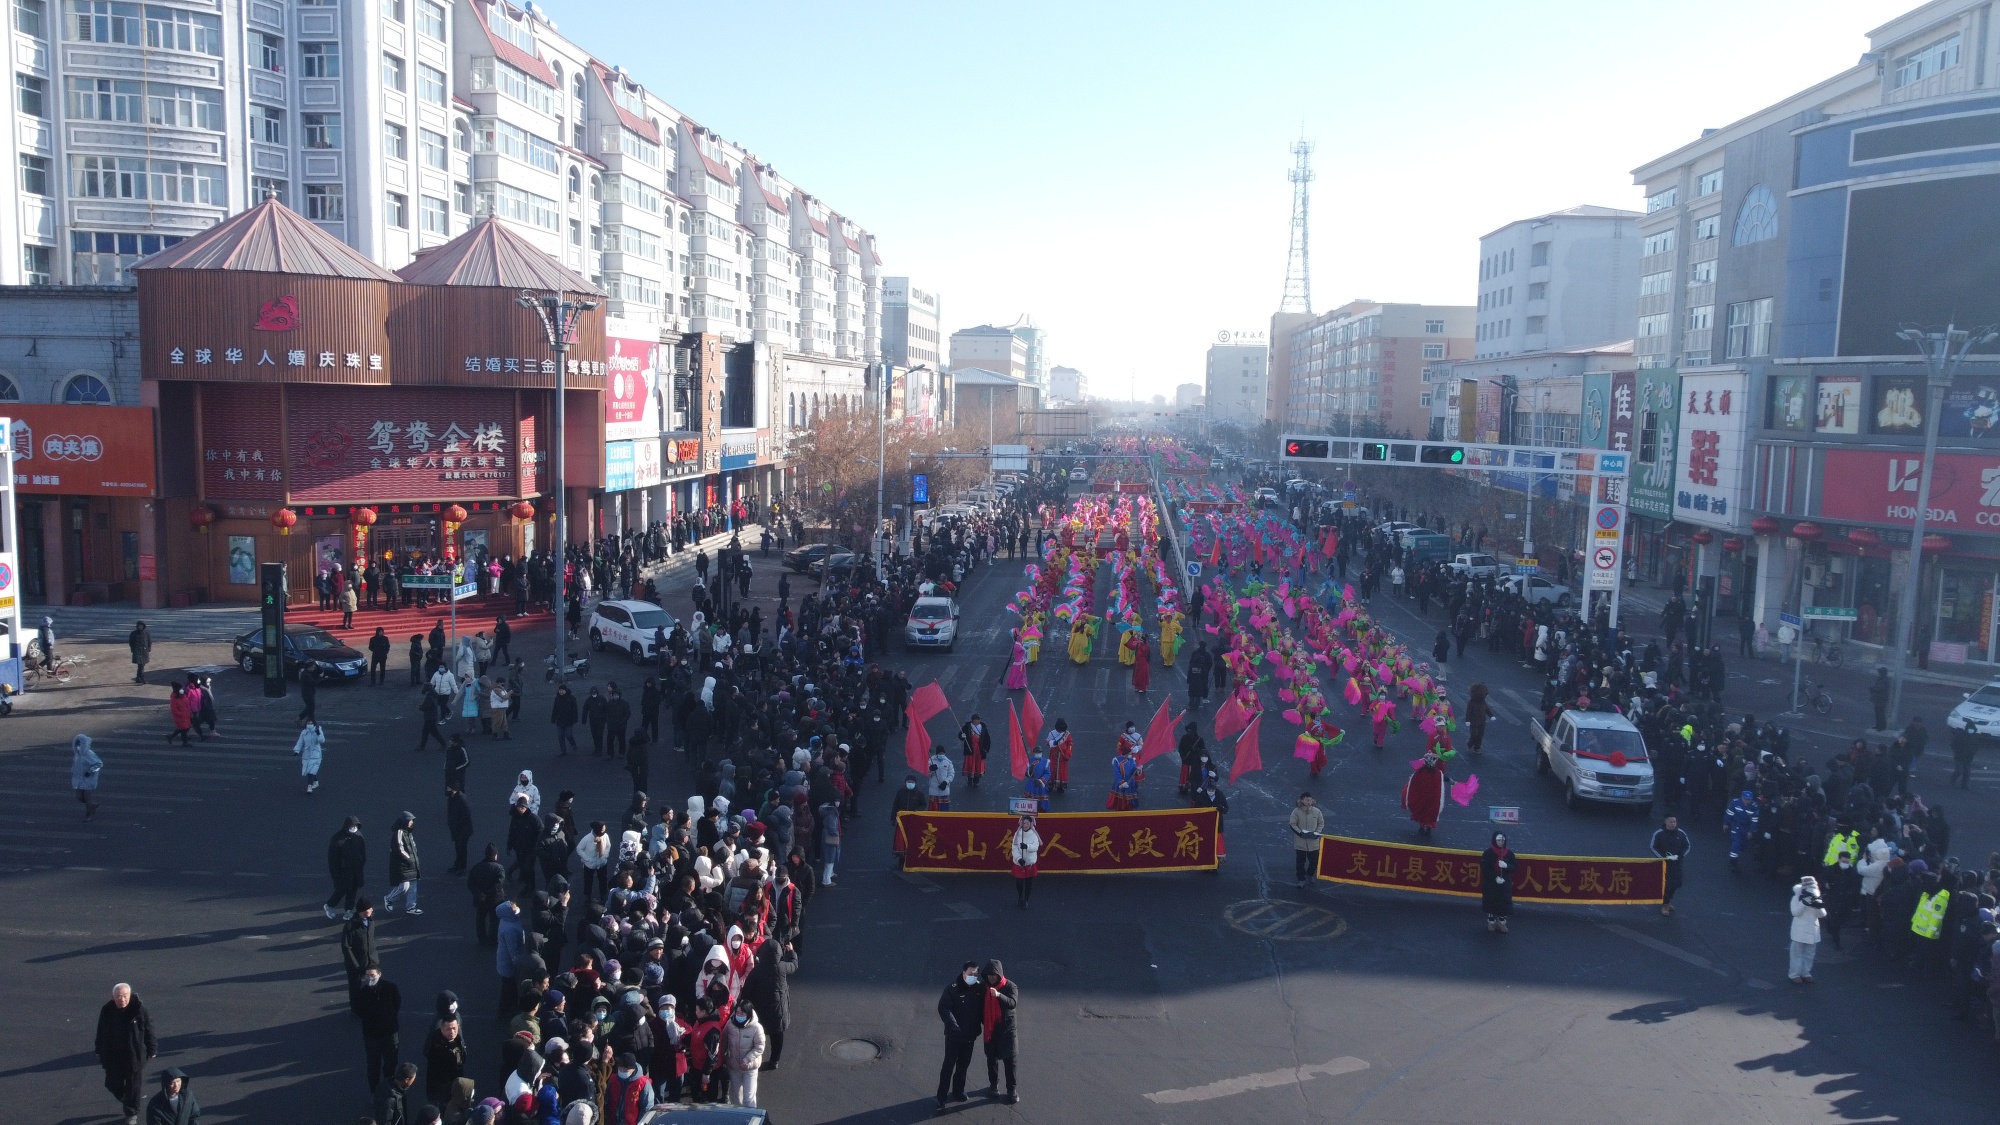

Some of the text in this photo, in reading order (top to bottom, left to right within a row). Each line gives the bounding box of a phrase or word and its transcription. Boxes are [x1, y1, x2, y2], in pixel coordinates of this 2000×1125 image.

[170, 346, 383, 371] 全球华人婚庆珠宝
[465, 356, 556, 374] 结婚买三金
[367, 419, 507, 454] 鸳鸯金楼
[47, 439, 99, 456] 肉夹馍
[206, 449, 264, 462] 你中有我
[370, 456, 506, 469] 全球华人婚庆珠宝
[1602, 459, 1623, 468] 中心岗
[1688, 429, 1720, 486] 鞋
[224, 468, 282, 481] 我中有你
[1887, 505, 1957, 523] HONGDA
[1346, 849, 1634, 896] 克山县双河人民政府
